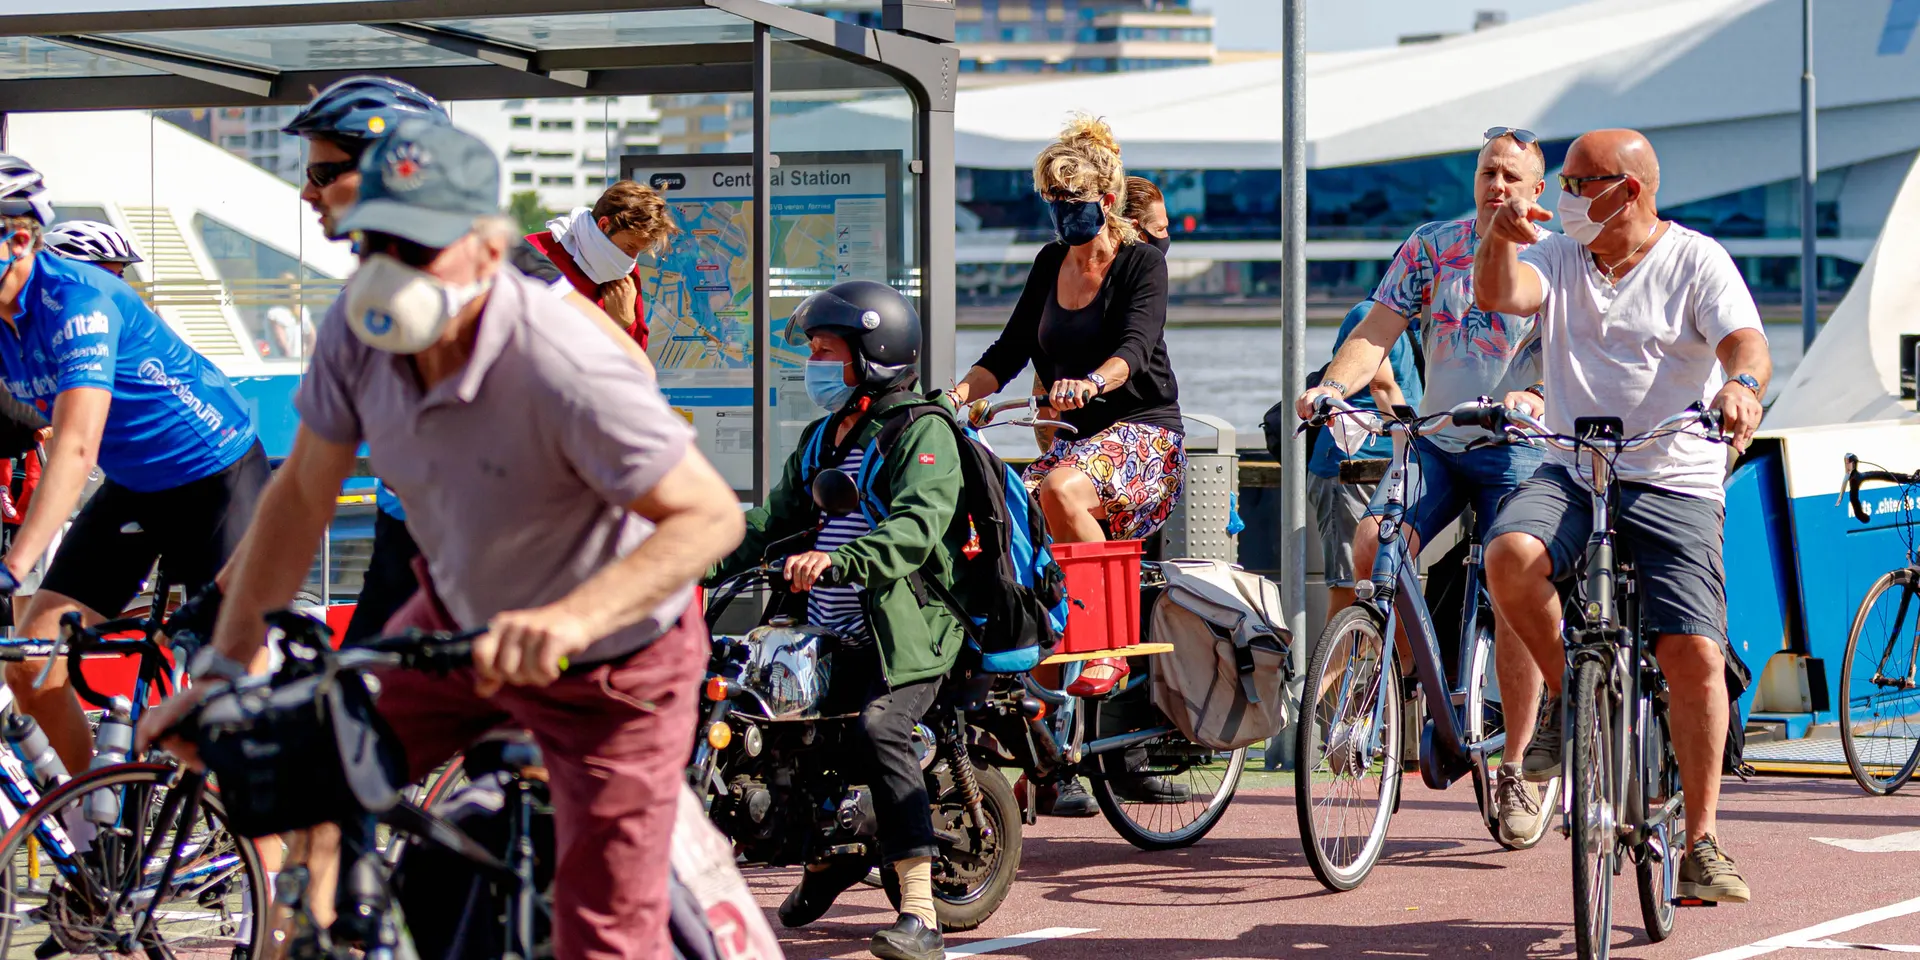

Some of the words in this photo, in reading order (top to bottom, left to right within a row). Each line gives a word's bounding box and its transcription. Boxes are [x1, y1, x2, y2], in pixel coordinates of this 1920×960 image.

[713, 171, 784, 187] Cental
[791, 169, 851, 185] Station
[1420, 608, 1441, 671] VOGUE
